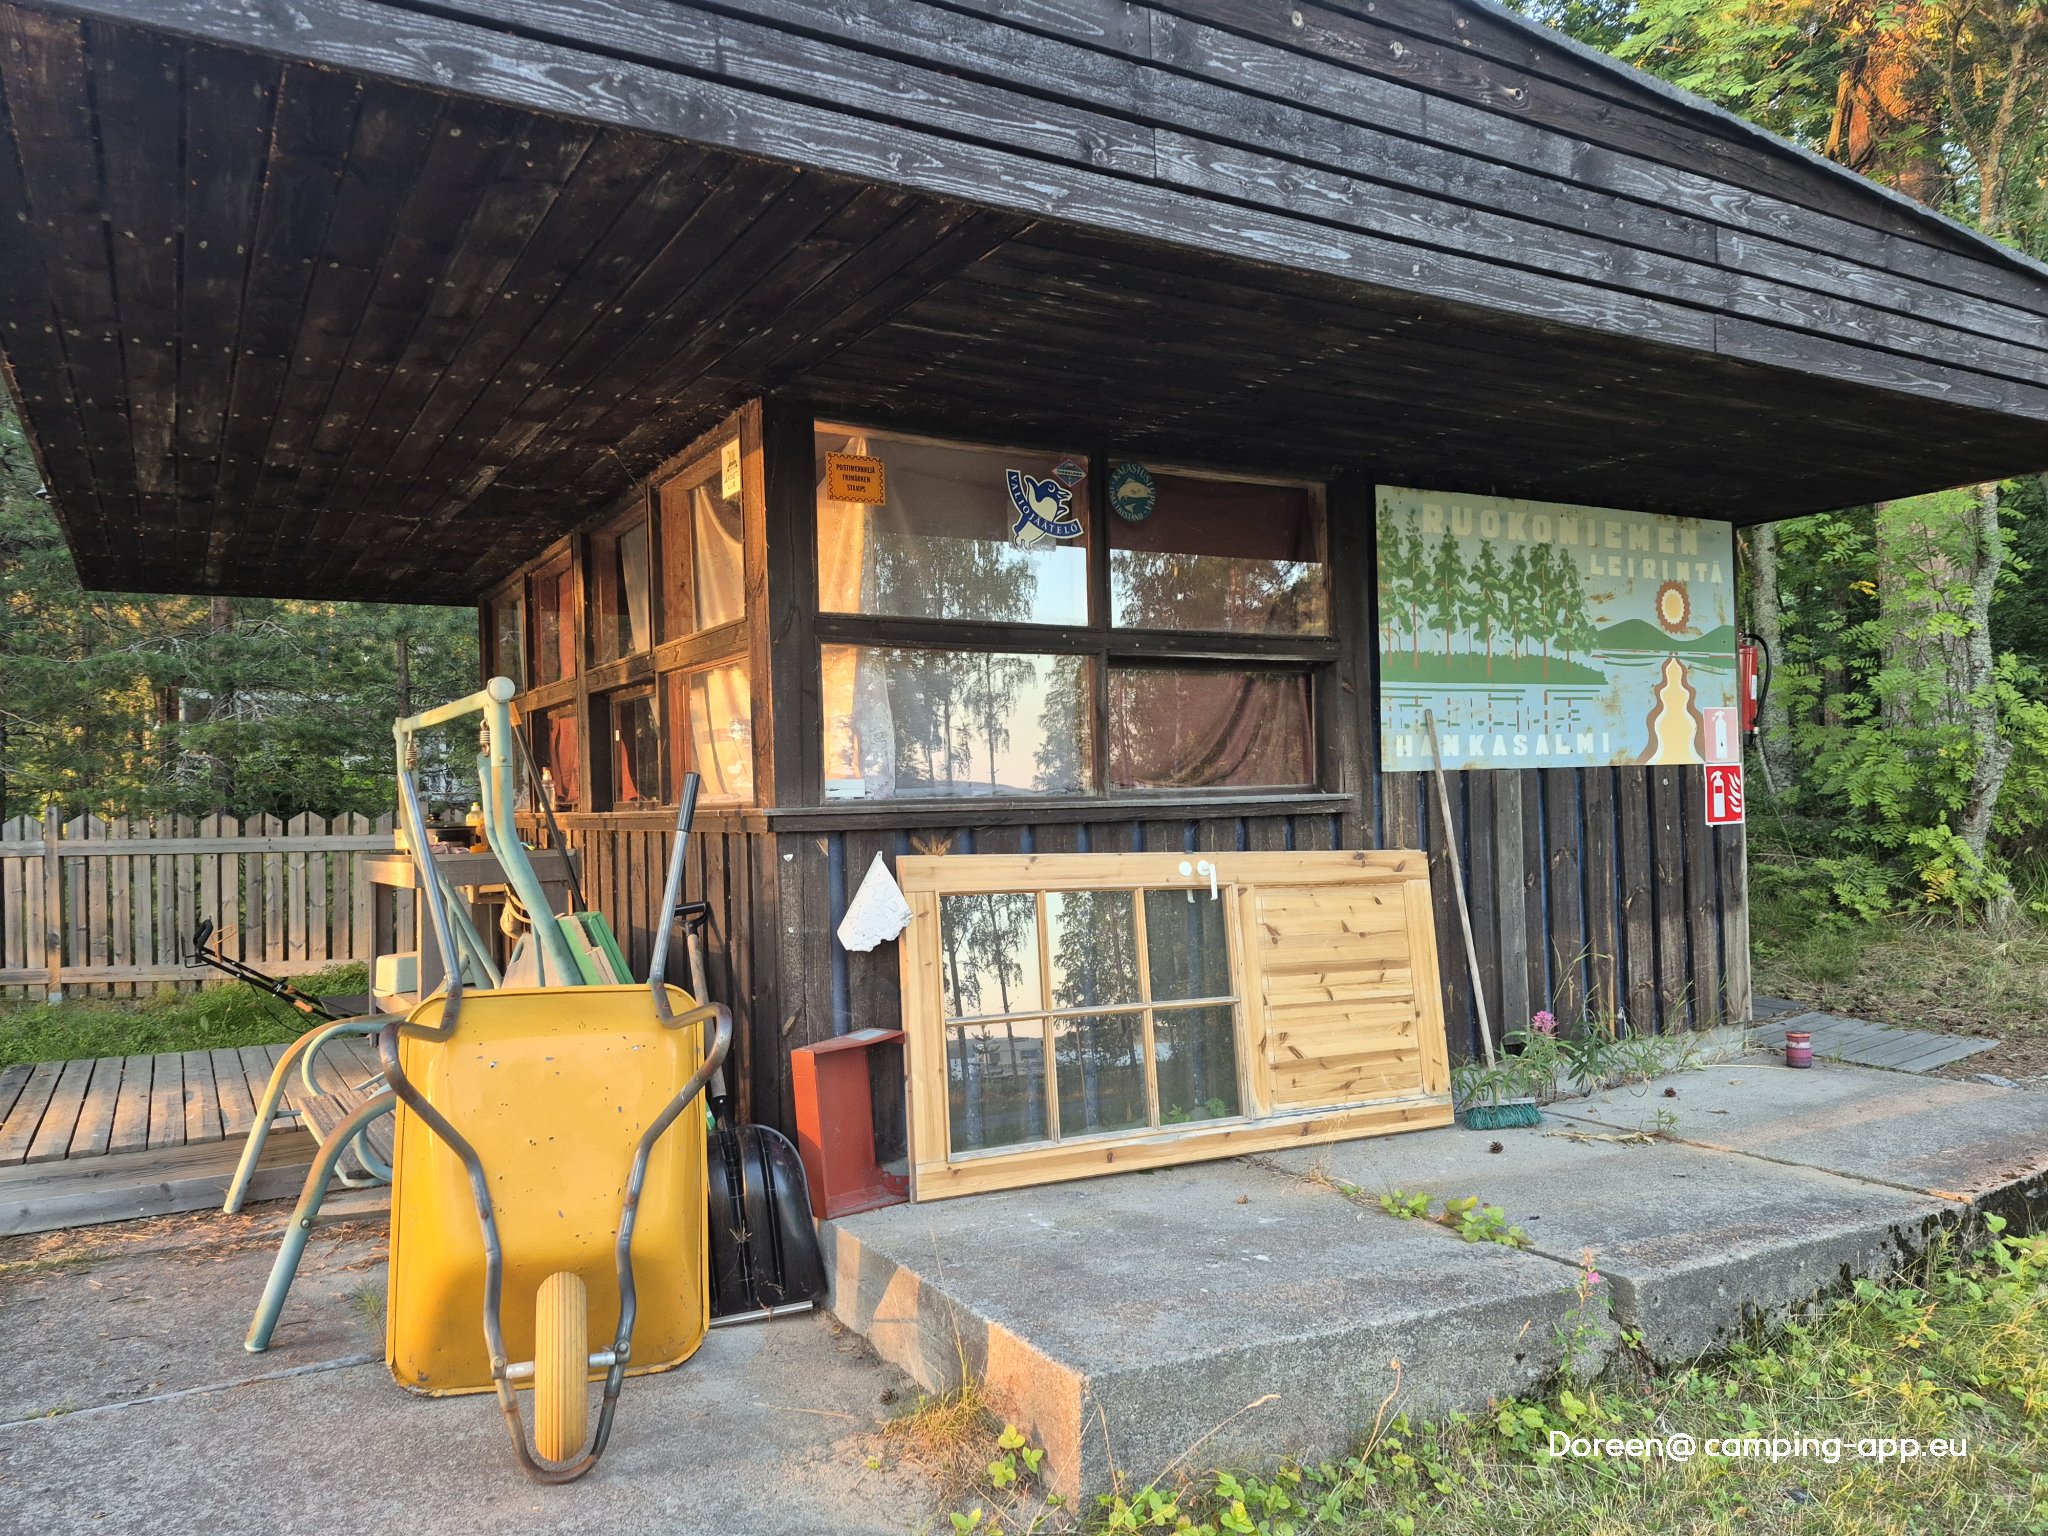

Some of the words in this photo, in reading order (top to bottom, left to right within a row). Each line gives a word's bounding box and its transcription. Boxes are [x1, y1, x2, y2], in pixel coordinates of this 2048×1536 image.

[847, 484, 866, 493] STAMPS
[1010, 474, 1030, 514] VALIO
[1028, 513, 1078, 534] JÄÄTELÖ
[1422, 503, 1698, 556] RUOKONIEMEN
[1590, 553, 1723, 584] LEIRINTÄ
[1396, 732, 1610, 757] HANKASALMI
